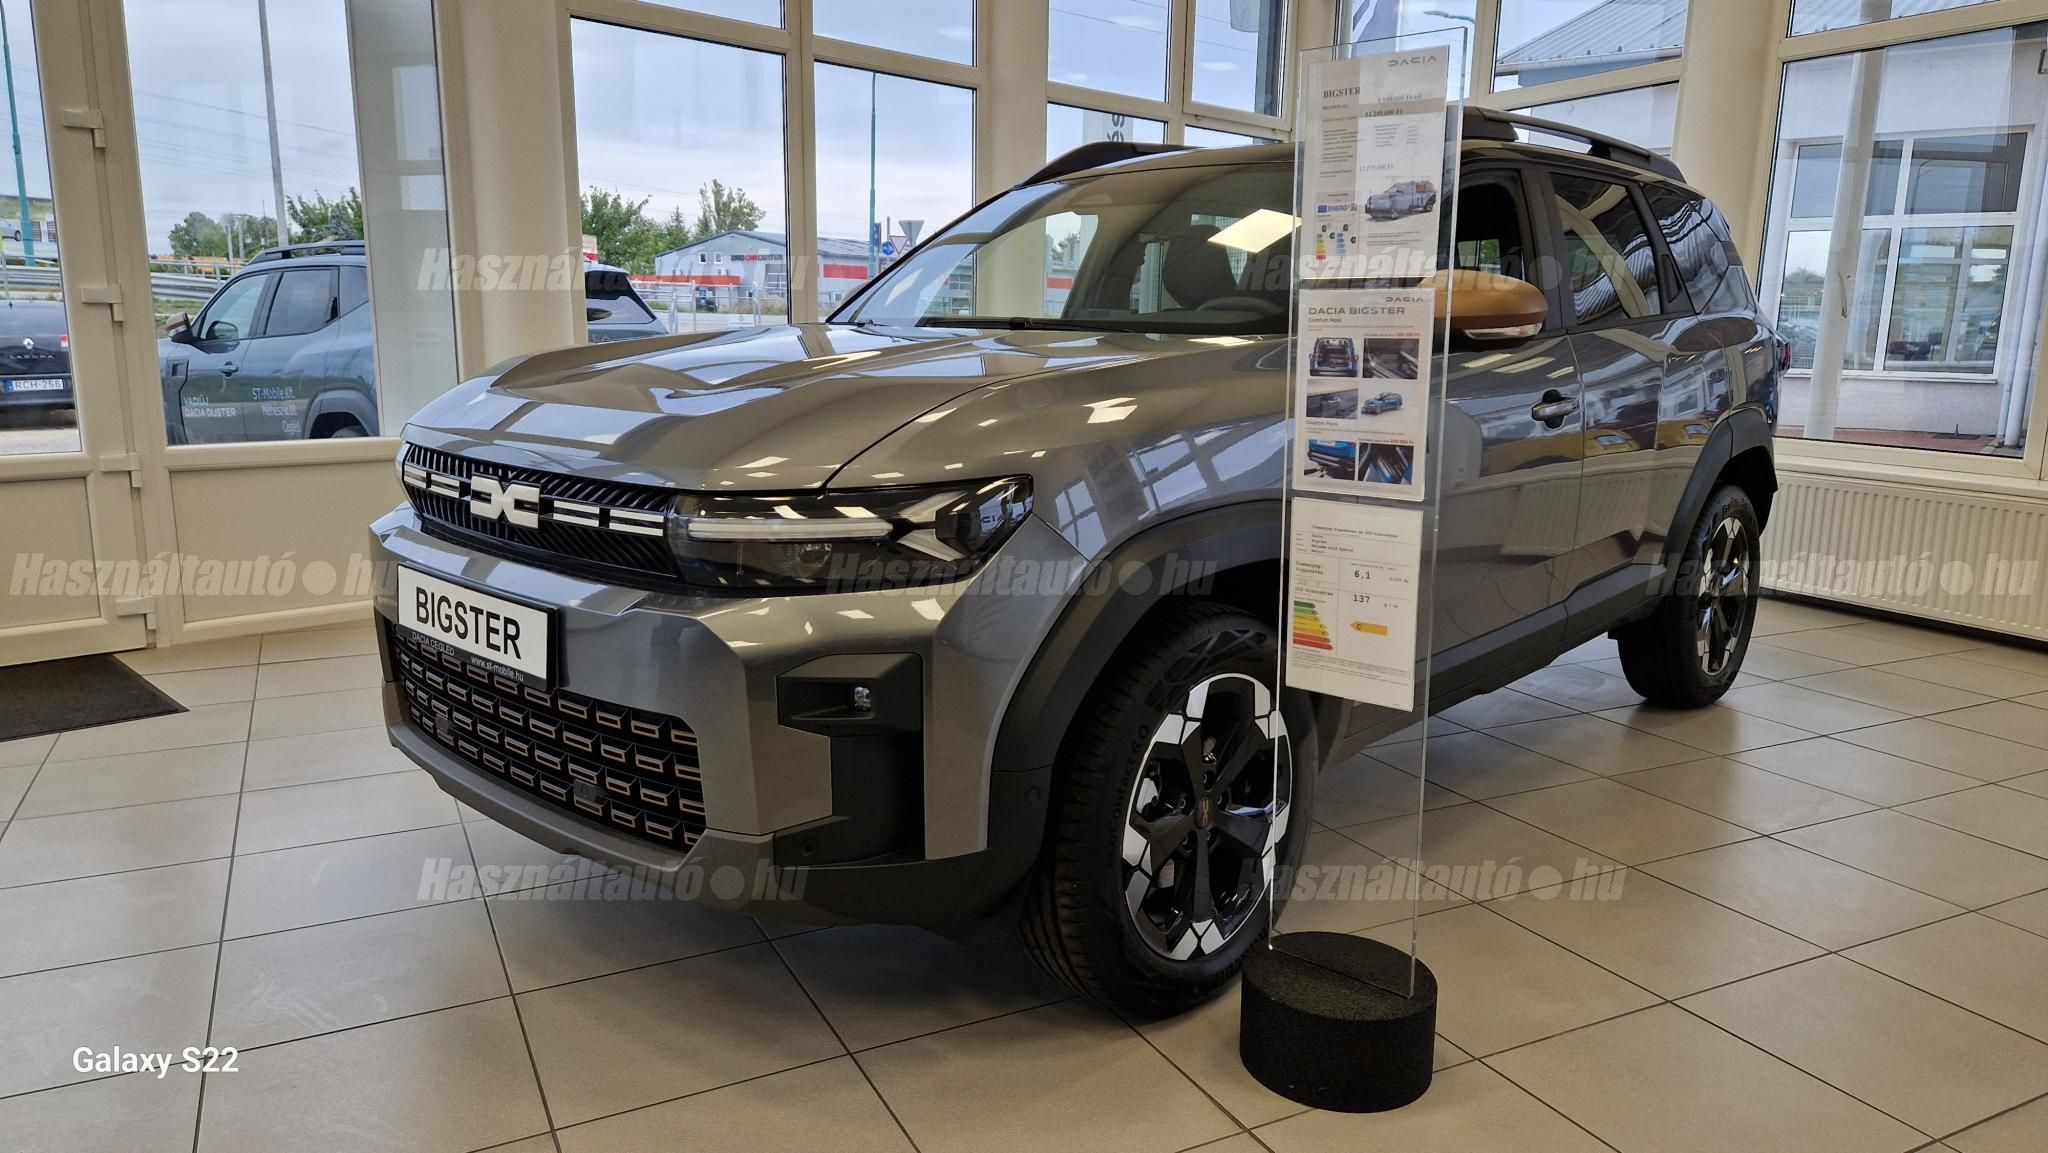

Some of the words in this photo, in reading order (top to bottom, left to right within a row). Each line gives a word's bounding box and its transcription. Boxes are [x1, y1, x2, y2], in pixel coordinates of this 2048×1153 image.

[1388, 55, 1437, 67] DACIA
[1323, 86, 1360, 99] BIGSTER
[1308, 306, 1346, 315] DACIA
[1349, 306, 1406, 315] BIGSTER
[185, 407, 205, 417] DACIA
[207, 407, 237, 417] DUSTER
[1354, 570, 1371, 580] 6,1
[1353, 594, 1371, 604] 137
[416, 586, 522, 660] BIGSTER
[412, 632, 430, 646] DACIA
[471, 655, 524, 682] www.st-mobile.hu
